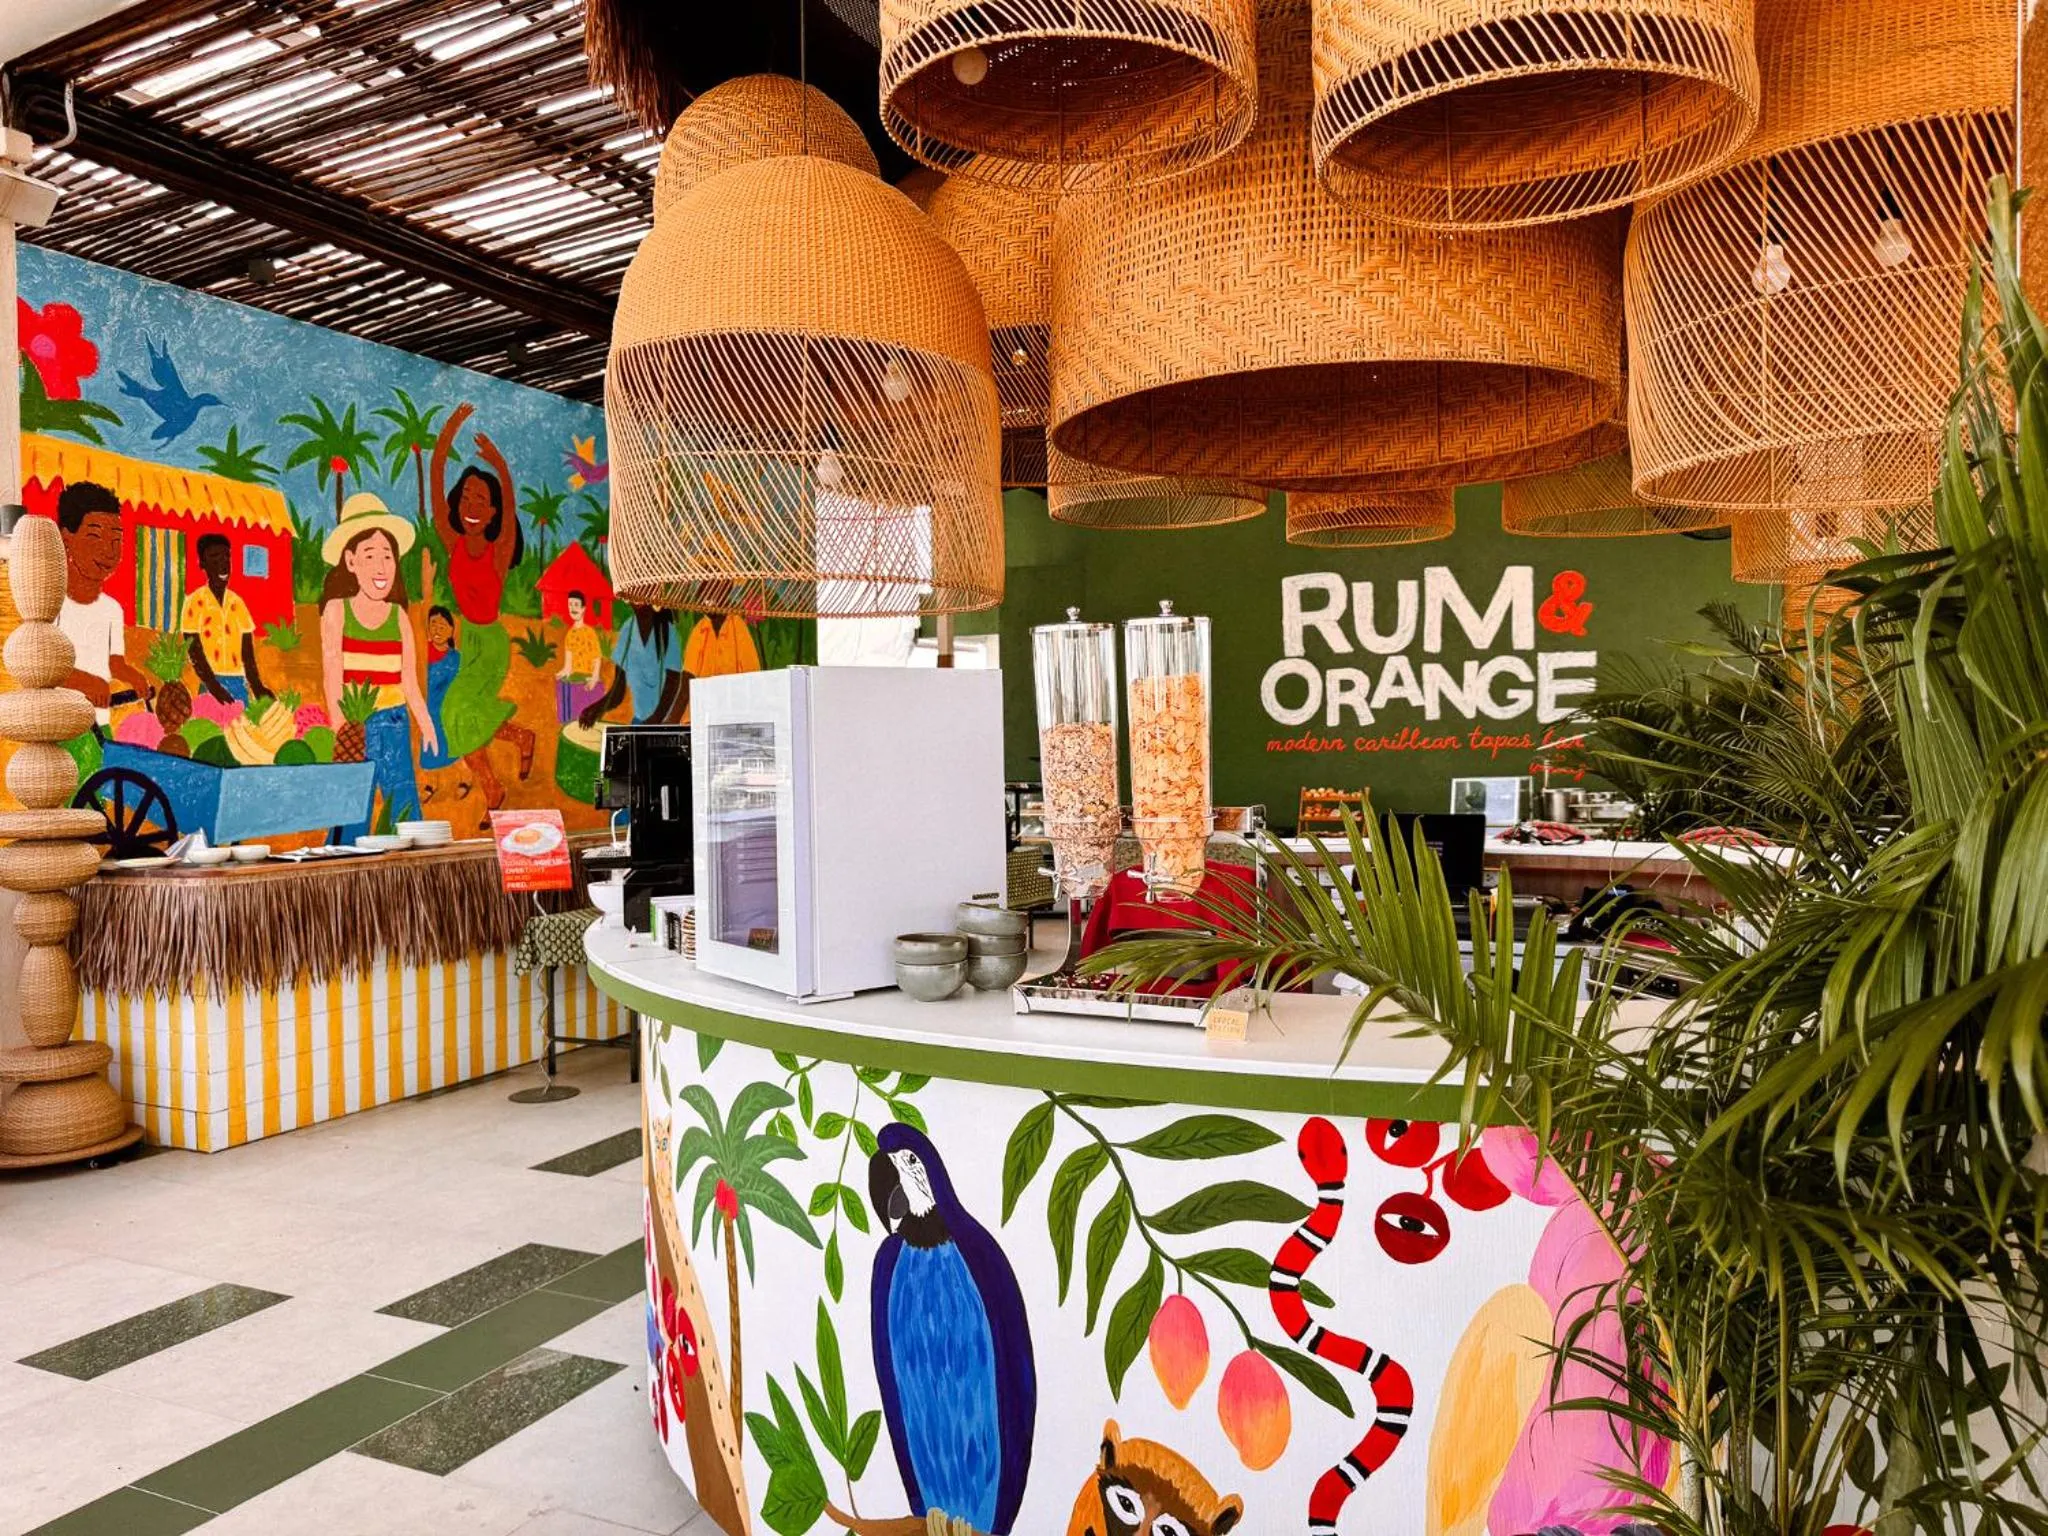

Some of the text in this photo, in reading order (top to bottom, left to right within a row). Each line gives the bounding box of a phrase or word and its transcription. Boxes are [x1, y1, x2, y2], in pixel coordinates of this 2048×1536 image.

[1281, 565, 1594, 657] RUM &
[1260, 650, 1598, 727] ORANGE
[1266, 728, 1348, 753] modern
[1354, 725, 1463, 752] caribbean
[1468, 723, 1536, 761] tapas
